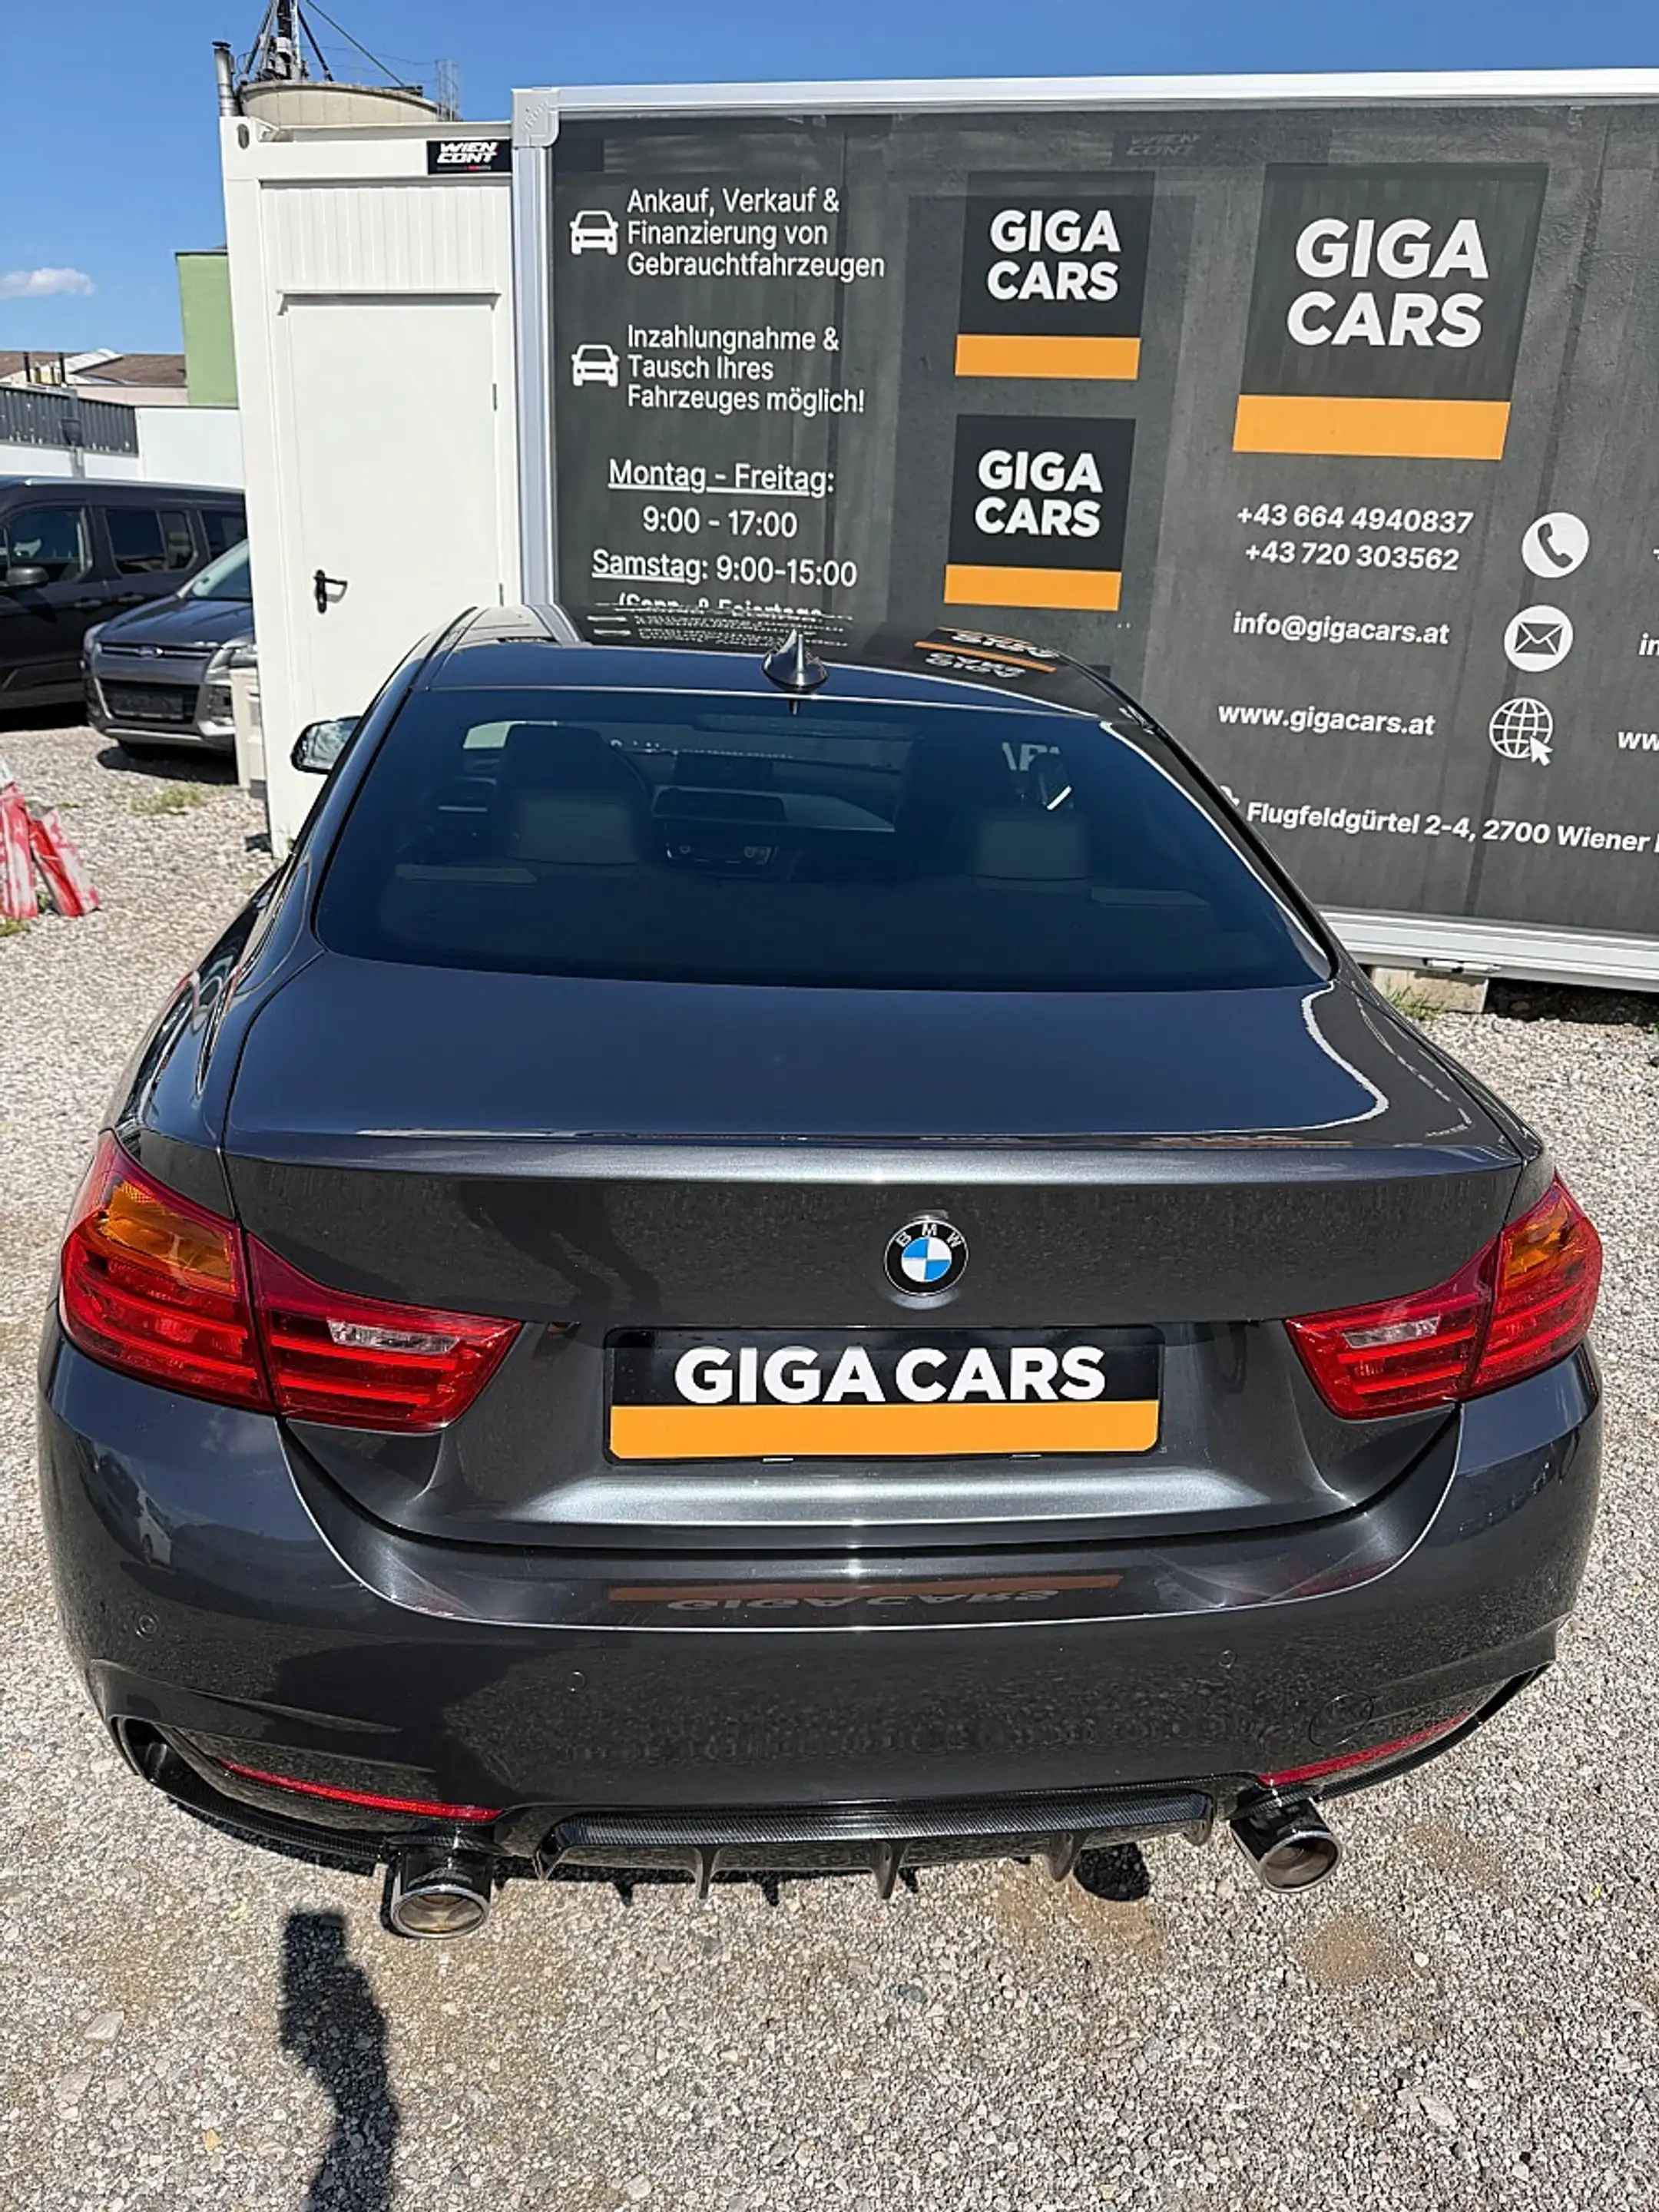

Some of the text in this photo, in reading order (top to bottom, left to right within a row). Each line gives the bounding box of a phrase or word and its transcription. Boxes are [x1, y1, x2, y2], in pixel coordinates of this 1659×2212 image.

[436, 152, 497, 164] CONT
[440, 141, 498, 152] WIEN
[627, 186, 839, 217] Ankauf, Verkauf &
[628, 219, 827, 250] Finanzierung von
[991, 210, 1121, 253] GIGA
[1296, 219, 1488, 279] GIGA
[628, 250, 884, 283] Gebrauchtfahrzeugen
[988, 260, 1118, 301] CARS
[1287, 291, 1483, 347] CARS
[628, 324, 839, 355] Inzahlungnahme &
[628, 354, 773, 380] Tausch Ihres
[628, 384, 864, 417] Fahrzeuges möglich!
[608, 459, 707, 494] Montag
[735, 462, 834, 498] Freitag:
[979, 450, 1103, 492] GIGA
[643, 505, 700, 534] 9:00
[728, 509, 797, 538] 17:00
[975, 497, 1101, 537] CARS
[1237, 503, 1474, 534] +43 664 4940837
[591, 548, 857, 587] Samstag: 9:00-15:00
[1245, 541, 1459, 571] +43 720 303562
[1233, 611, 1450, 644] info@gigacars.at
[1218, 706, 1436, 736] www.gigacars.at
[1247, 802, 1420, 834] Flugfeldgürtel
[1424, 815, 1475, 842] 2-4,
[1482, 820, 1551, 844] 2700
[1557, 825, 1651, 852] Wiener
[896, 1224, 962, 1247] BMW
[675, 1346, 1105, 1404] GIGA CARS
